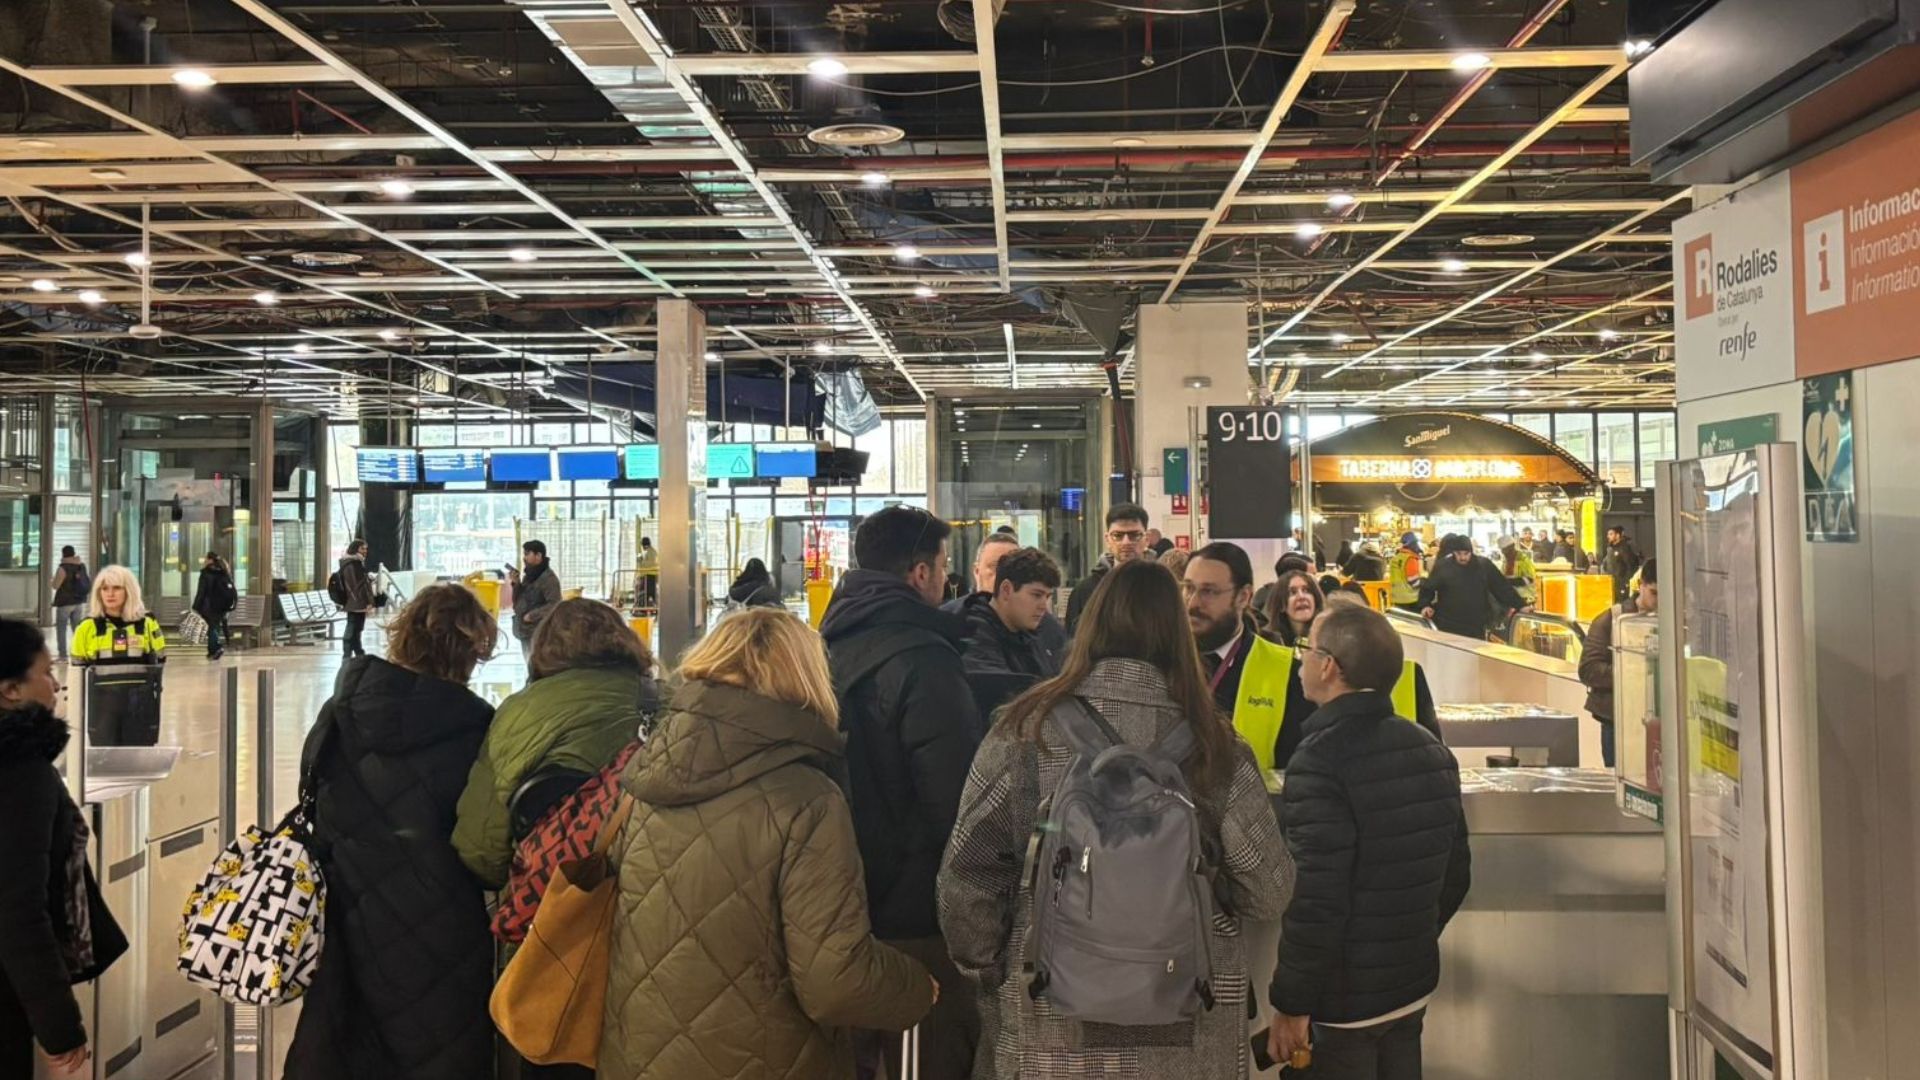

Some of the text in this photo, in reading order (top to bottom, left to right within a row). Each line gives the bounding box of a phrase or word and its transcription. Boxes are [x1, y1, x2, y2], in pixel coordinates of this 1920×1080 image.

[1850, 222, 1920, 268] Informació
[1717, 248, 1777, 291] Rodalies
[1717, 285, 1763, 312] de Catalunya
[1719, 321, 1757, 361] renfe
